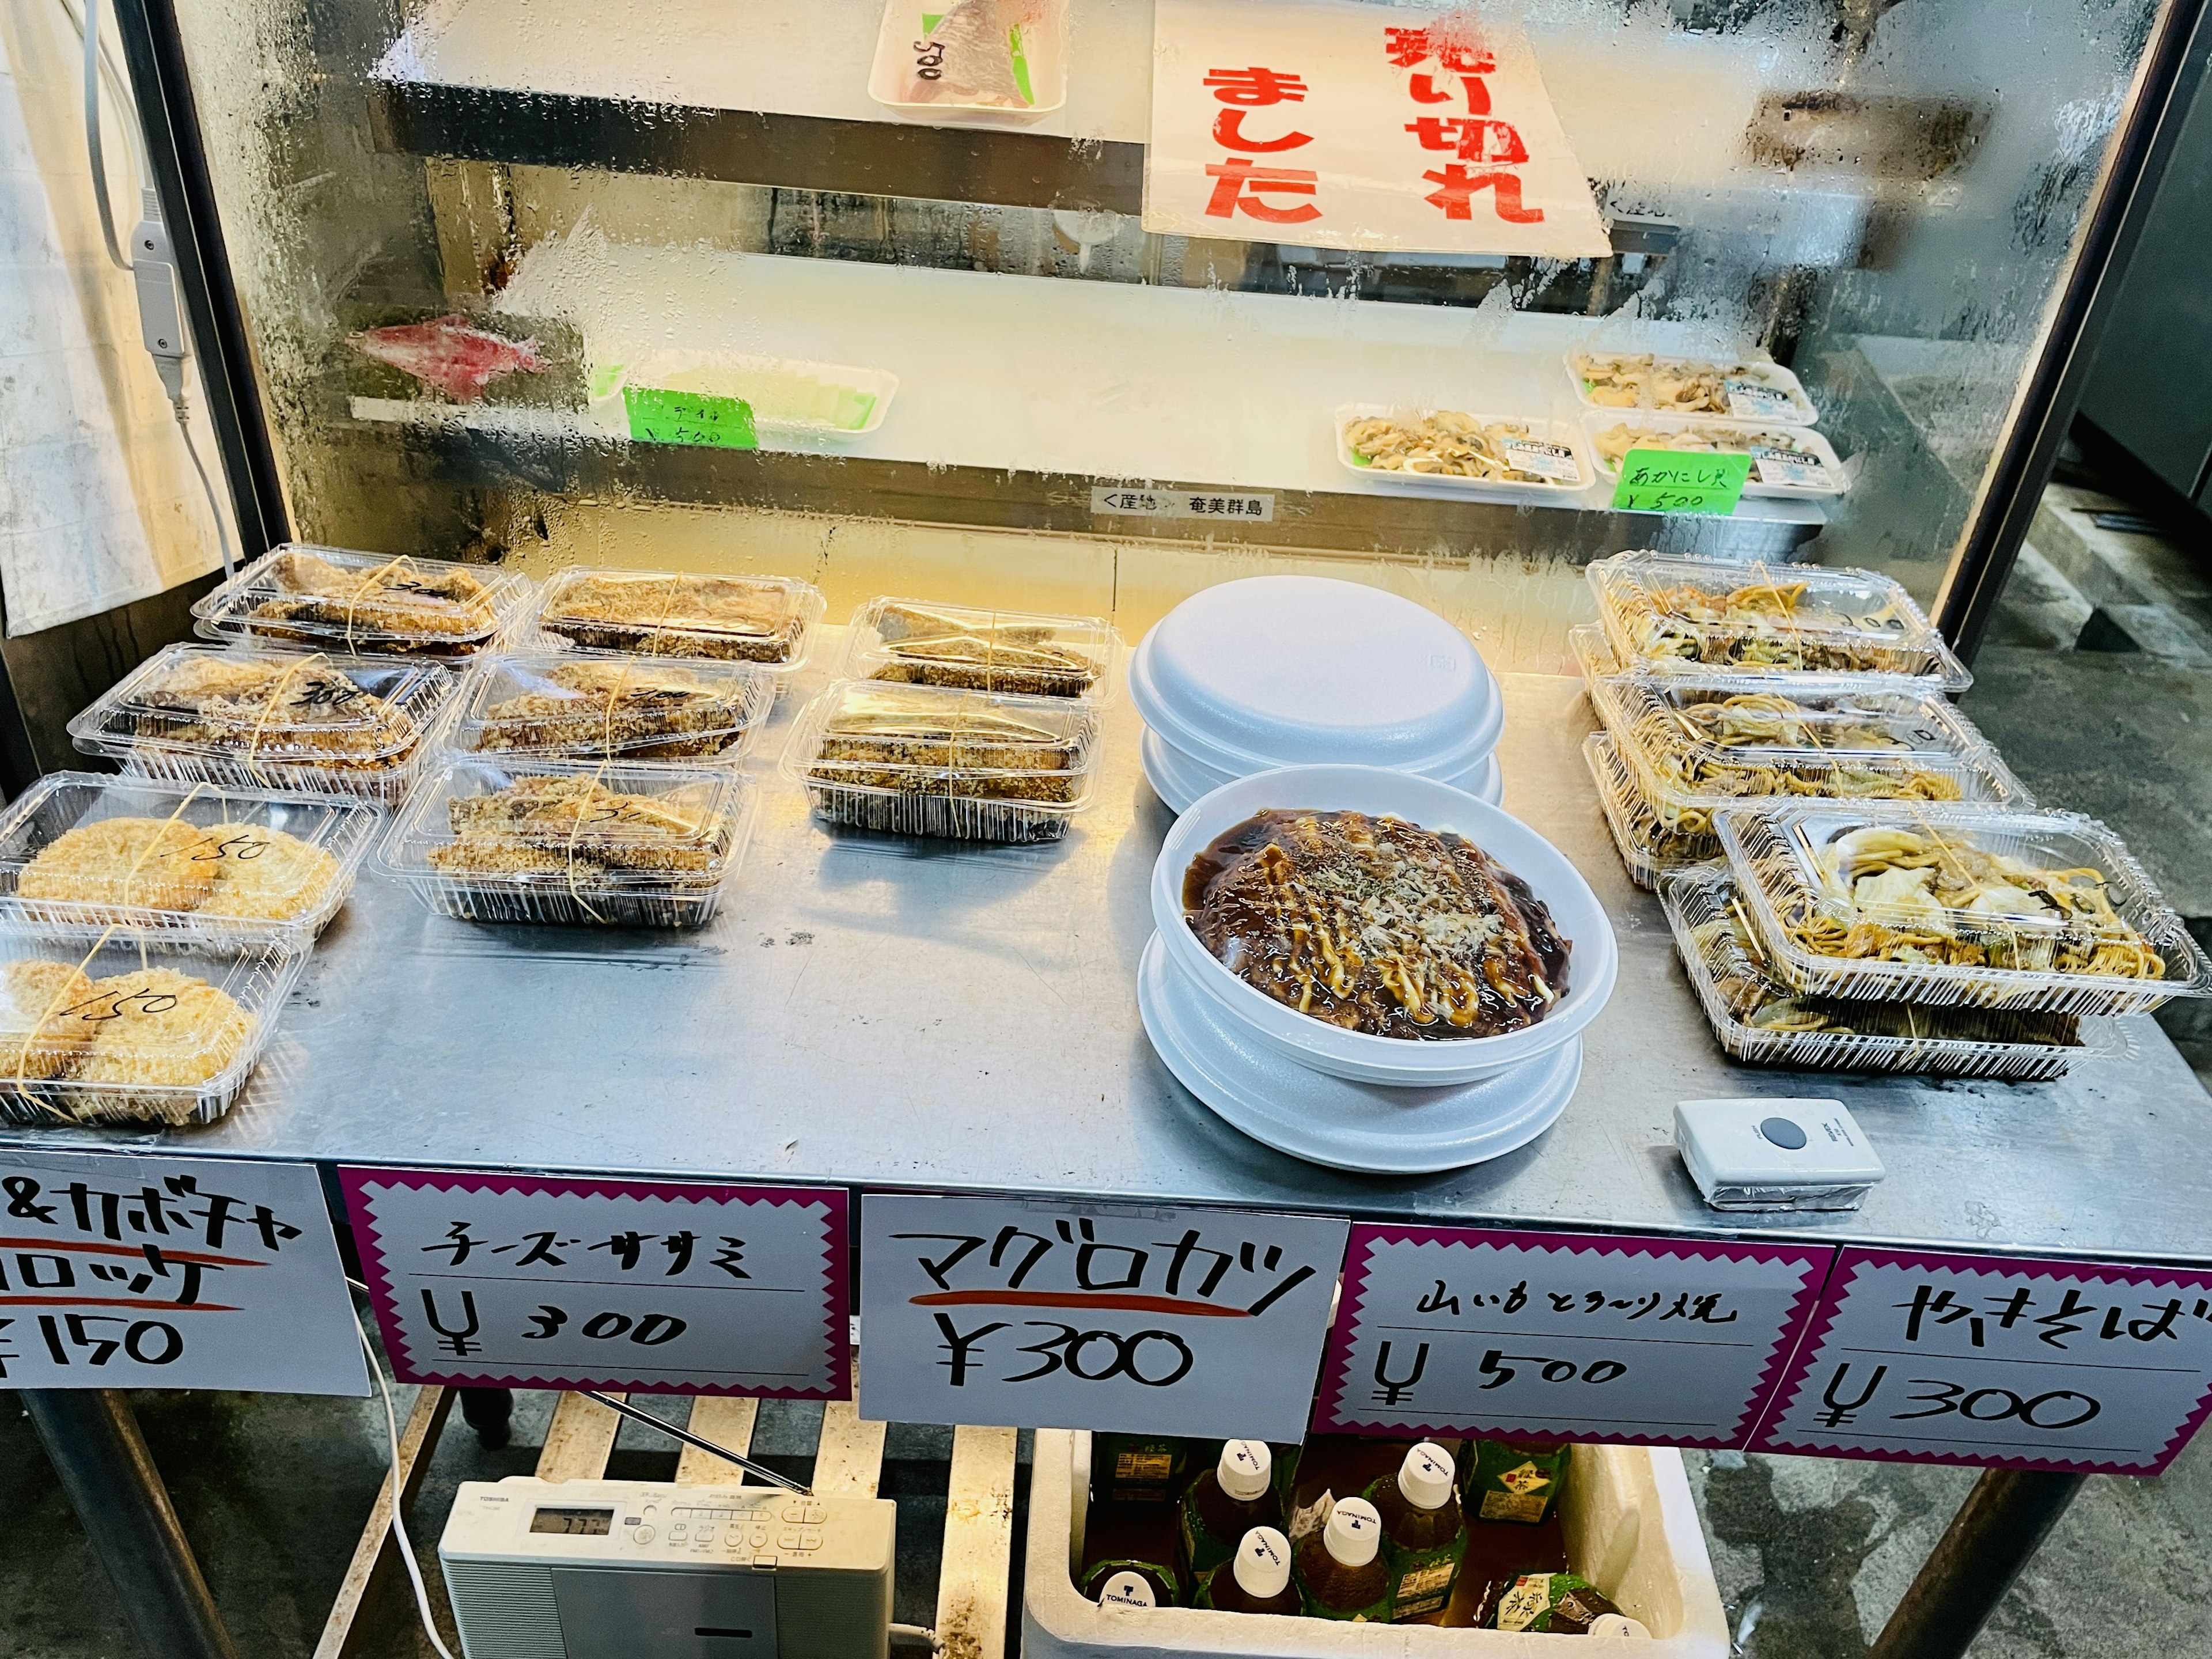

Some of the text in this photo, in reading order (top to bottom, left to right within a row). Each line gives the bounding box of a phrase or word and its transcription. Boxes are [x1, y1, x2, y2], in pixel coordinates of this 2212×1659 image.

[913, 41, 945, 79] 500
[1203, 67, 1323, 224] ました
[1189, 497, 1263, 516] 奄美群島
[160, 835, 270, 861] 150
[59, 988, 177, 1021] 150
[421, 1221, 752, 1279] チーズササミ
[933, 1313, 1194, 1387] ¥300
[1240, 1441, 1260, 1470] TOMINAG
[1416, 1448, 1448, 1476] TOMINAGA
[1336, 1510, 1377, 1524] TOMINAGA
[1255, 1531, 1281, 1566] TOMINAGA
[1106, 1594, 1147, 1607] TOMINAGA
